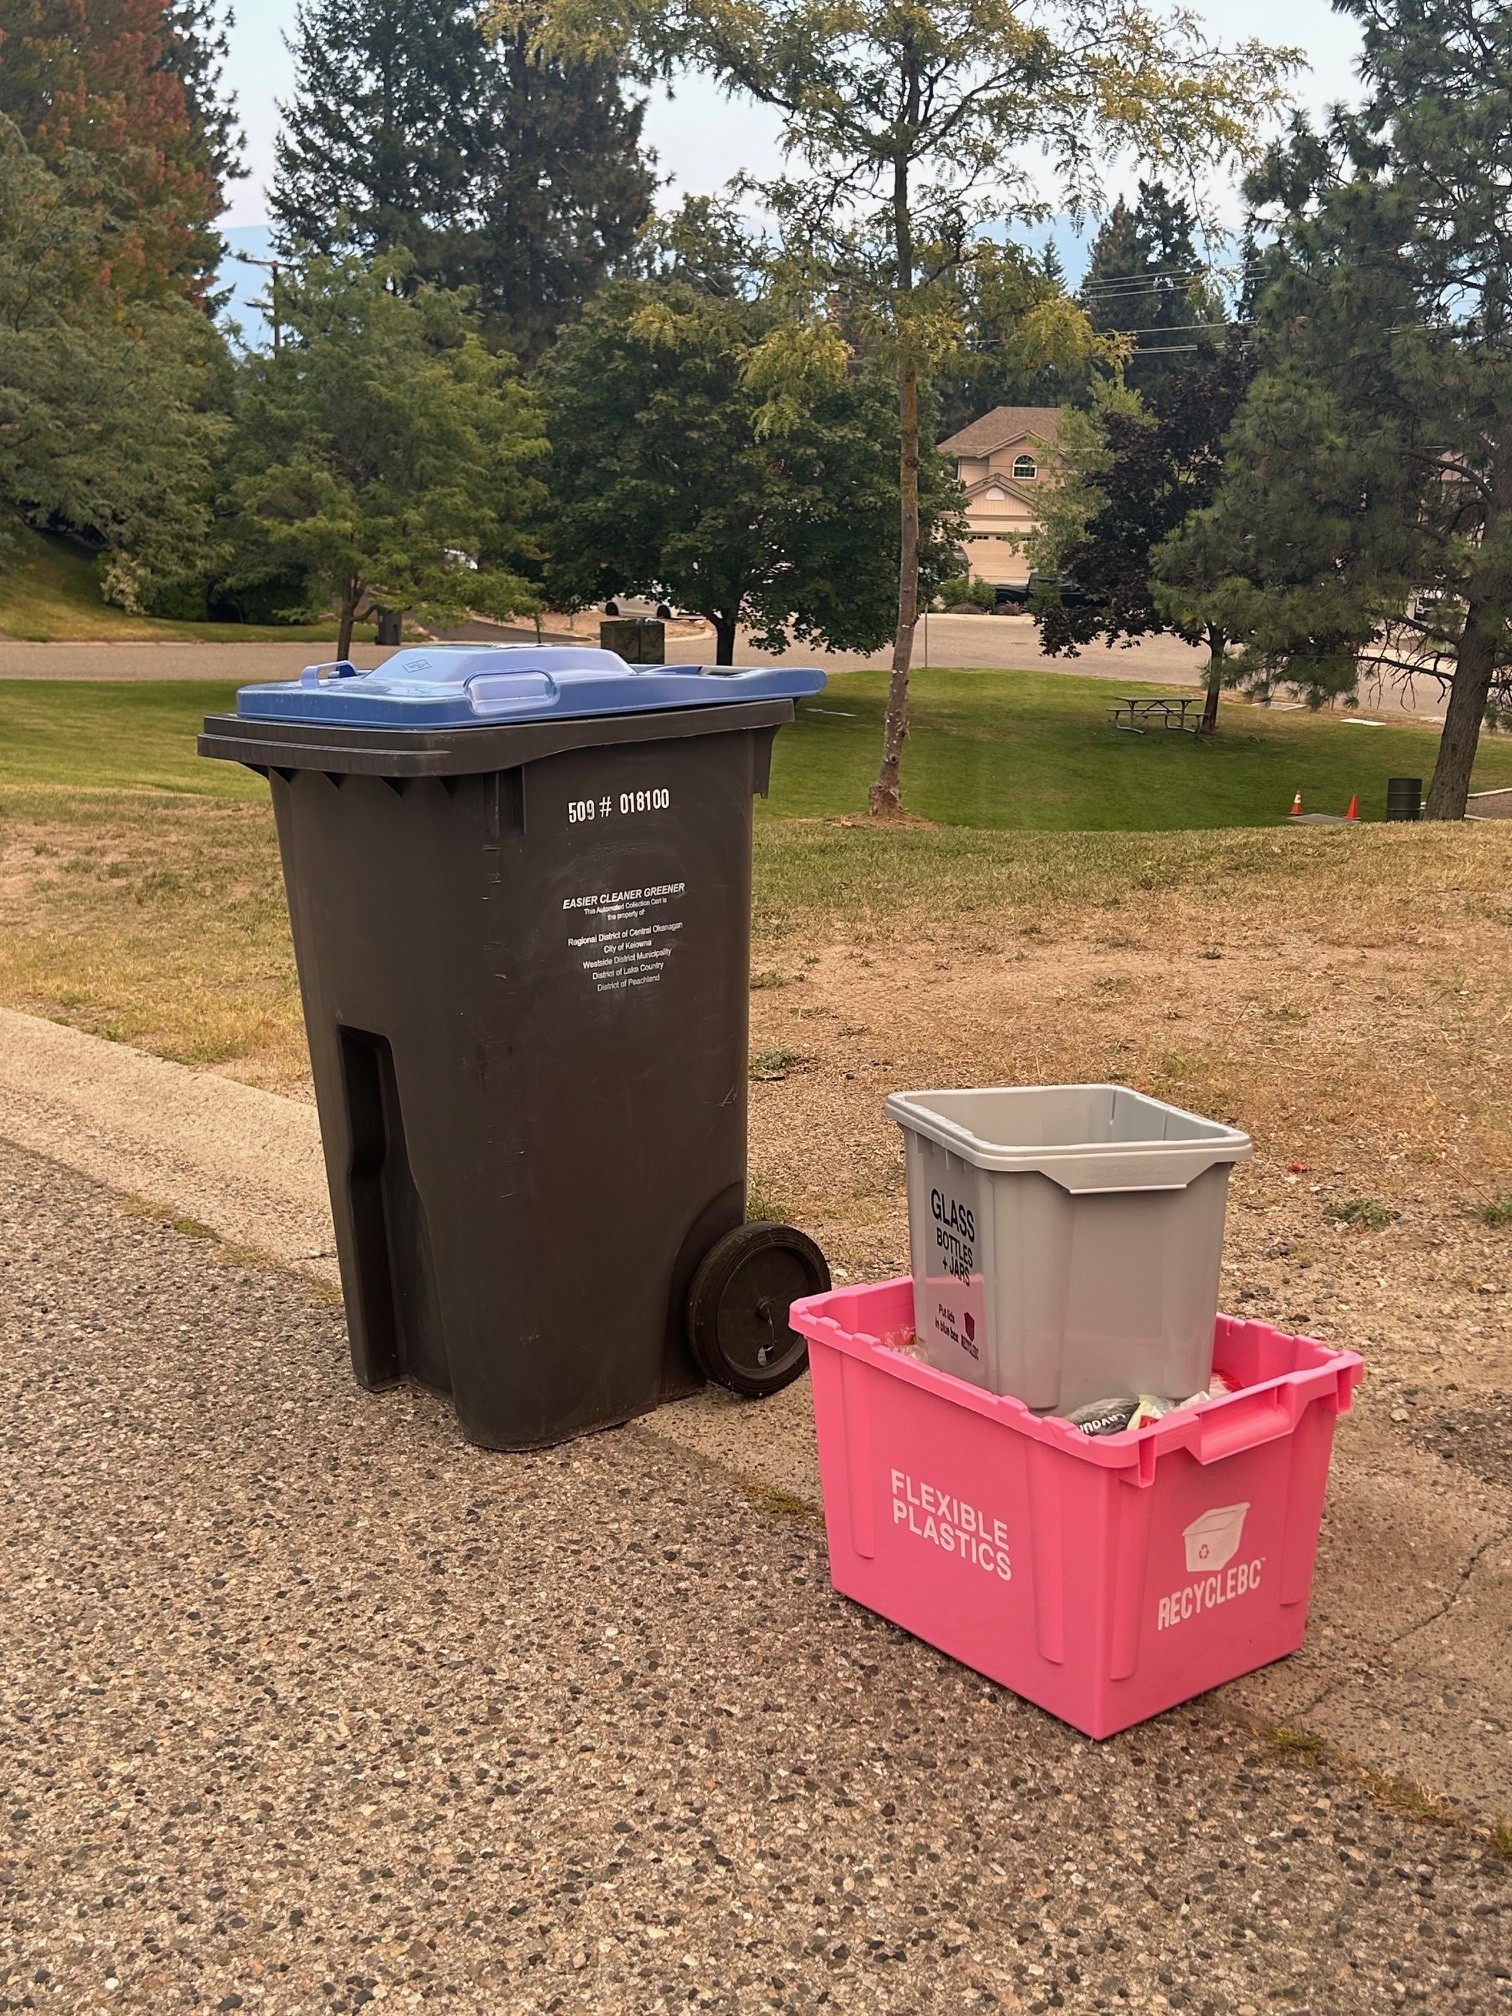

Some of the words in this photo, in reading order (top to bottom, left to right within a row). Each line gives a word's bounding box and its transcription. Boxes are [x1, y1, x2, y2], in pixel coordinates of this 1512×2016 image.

[568, 799, 595, 823] 509
[599, 796, 612, 818] #
[620, 788, 670, 814] 018100
[562, 895, 598, 909] EASIER
[599, 889, 642, 903] CLEANER
[644, 882, 686, 898] GREENER
[584, 907, 596, 915] This
[625, 899, 650, 909] Collection
[617, 910, 638, 921] property
[568, 935, 597, 947] Regional
[599, 931, 621, 942] District
[622, 930, 628, 938] of
[629, 925, 652, 936] Central
[653, 922, 683, 933] Okanagan
[604, 944, 617, 953] City
[618, 942, 625, 950] of
[625, 939, 652, 950] Kelowna
[583, 958, 613, 969] Westside
[614, 953, 636, 963] District
[636, 948, 672, 960] Municipality
[593, 970, 615, 980] District
[616, 968, 622, 976] of
[624, 965, 639, 975] Lake
[640, 961, 664, 972] Country
[597, 982, 619, 991] District
[620, 979, 627, 988] of
[628, 974, 660, 986] Peachland
[931, 1188, 975, 1242] GLASS
[936, 1226, 973, 1268] BOTTLES
[949, 1256, 970, 1287] JARS
[890, 1468, 1009, 1551] FLEXIBLE
[893, 1497, 1012, 1581] PLASTICS
